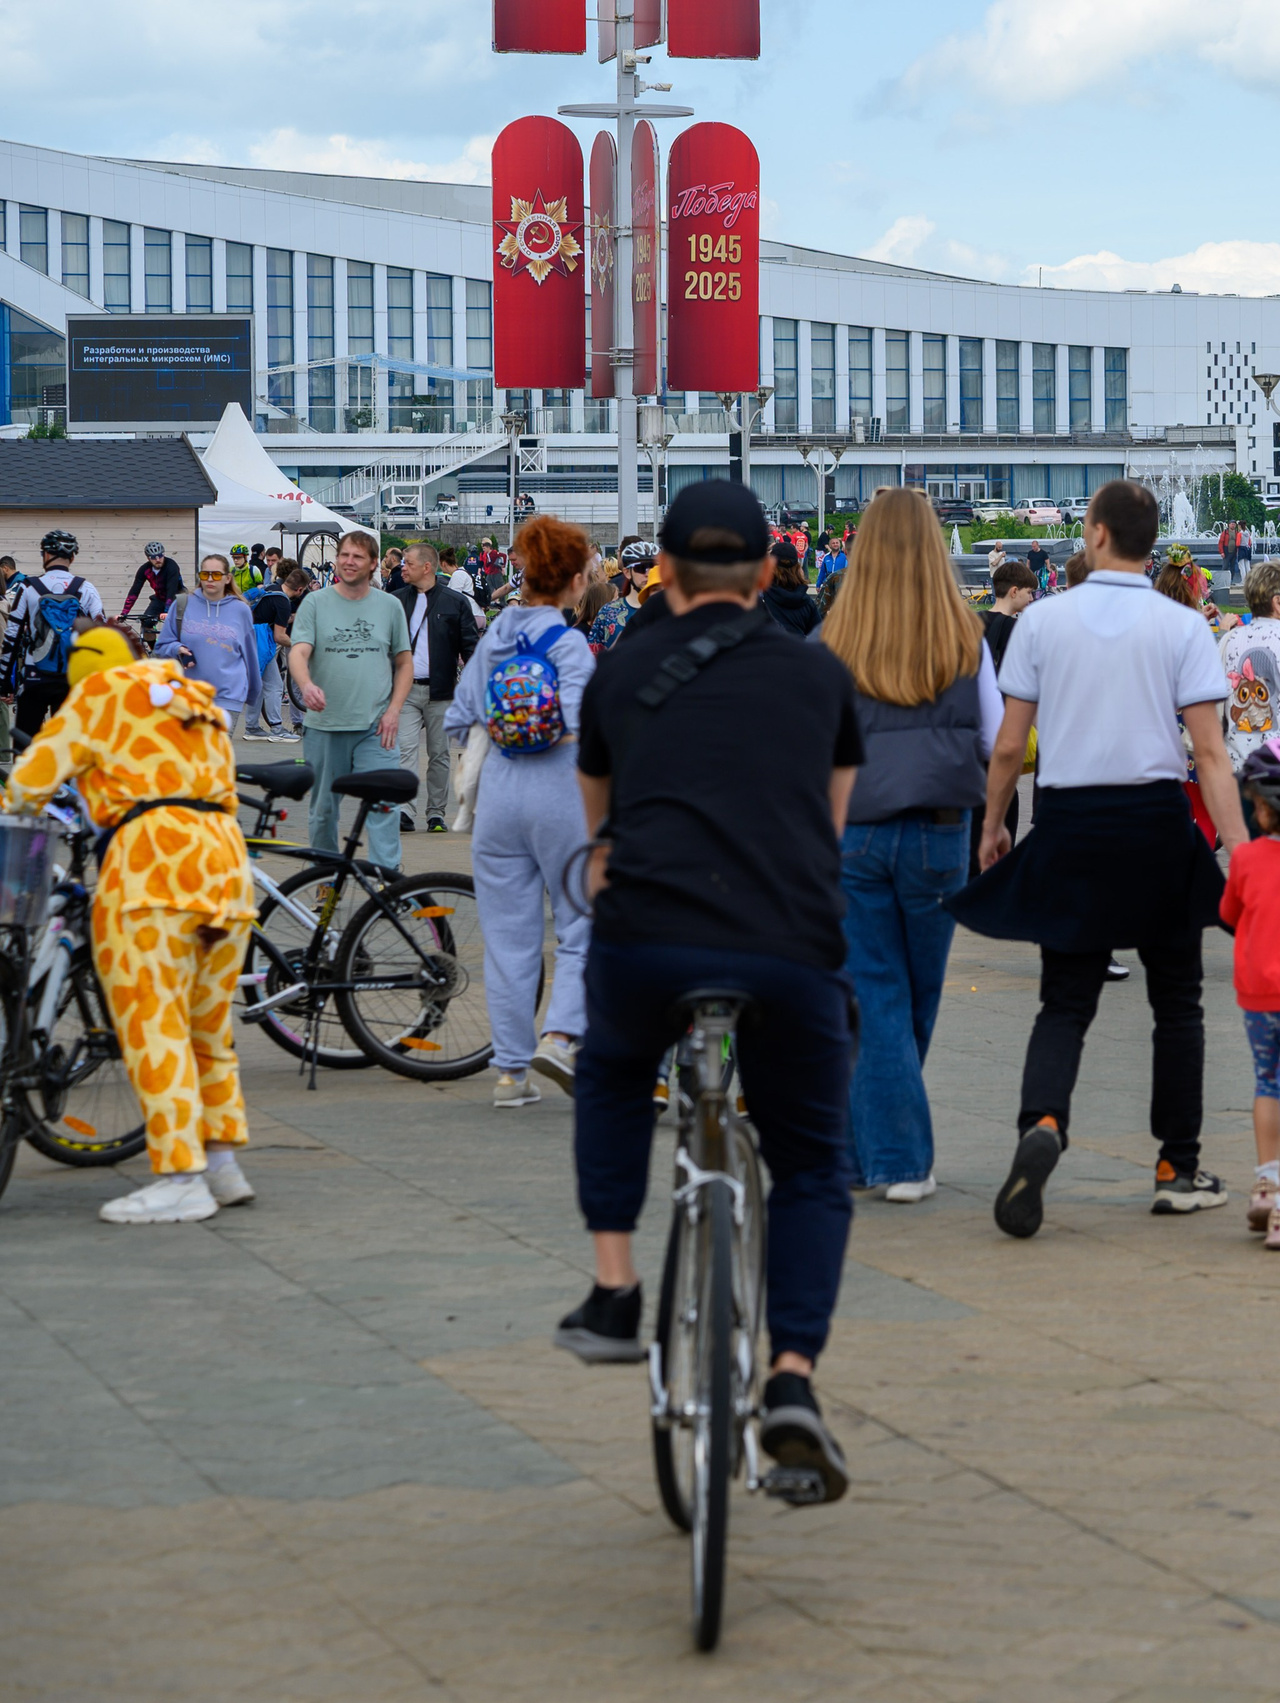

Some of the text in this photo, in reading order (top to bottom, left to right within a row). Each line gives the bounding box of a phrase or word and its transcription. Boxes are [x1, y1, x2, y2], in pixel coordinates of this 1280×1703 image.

[671, 181, 757, 228] Победа
[636, 234, 651, 263] 1945
[687, 234, 742, 263] 1945
[635, 273, 652, 302] 2025
[684, 271, 742, 300] 2025
[83, 346, 136, 355] Разработки
[147, 347, 211, 355] производства
[83, 354, 231, 364] интегральных микросхем (ИМС)
[494, 680, 544, 699] PAW
